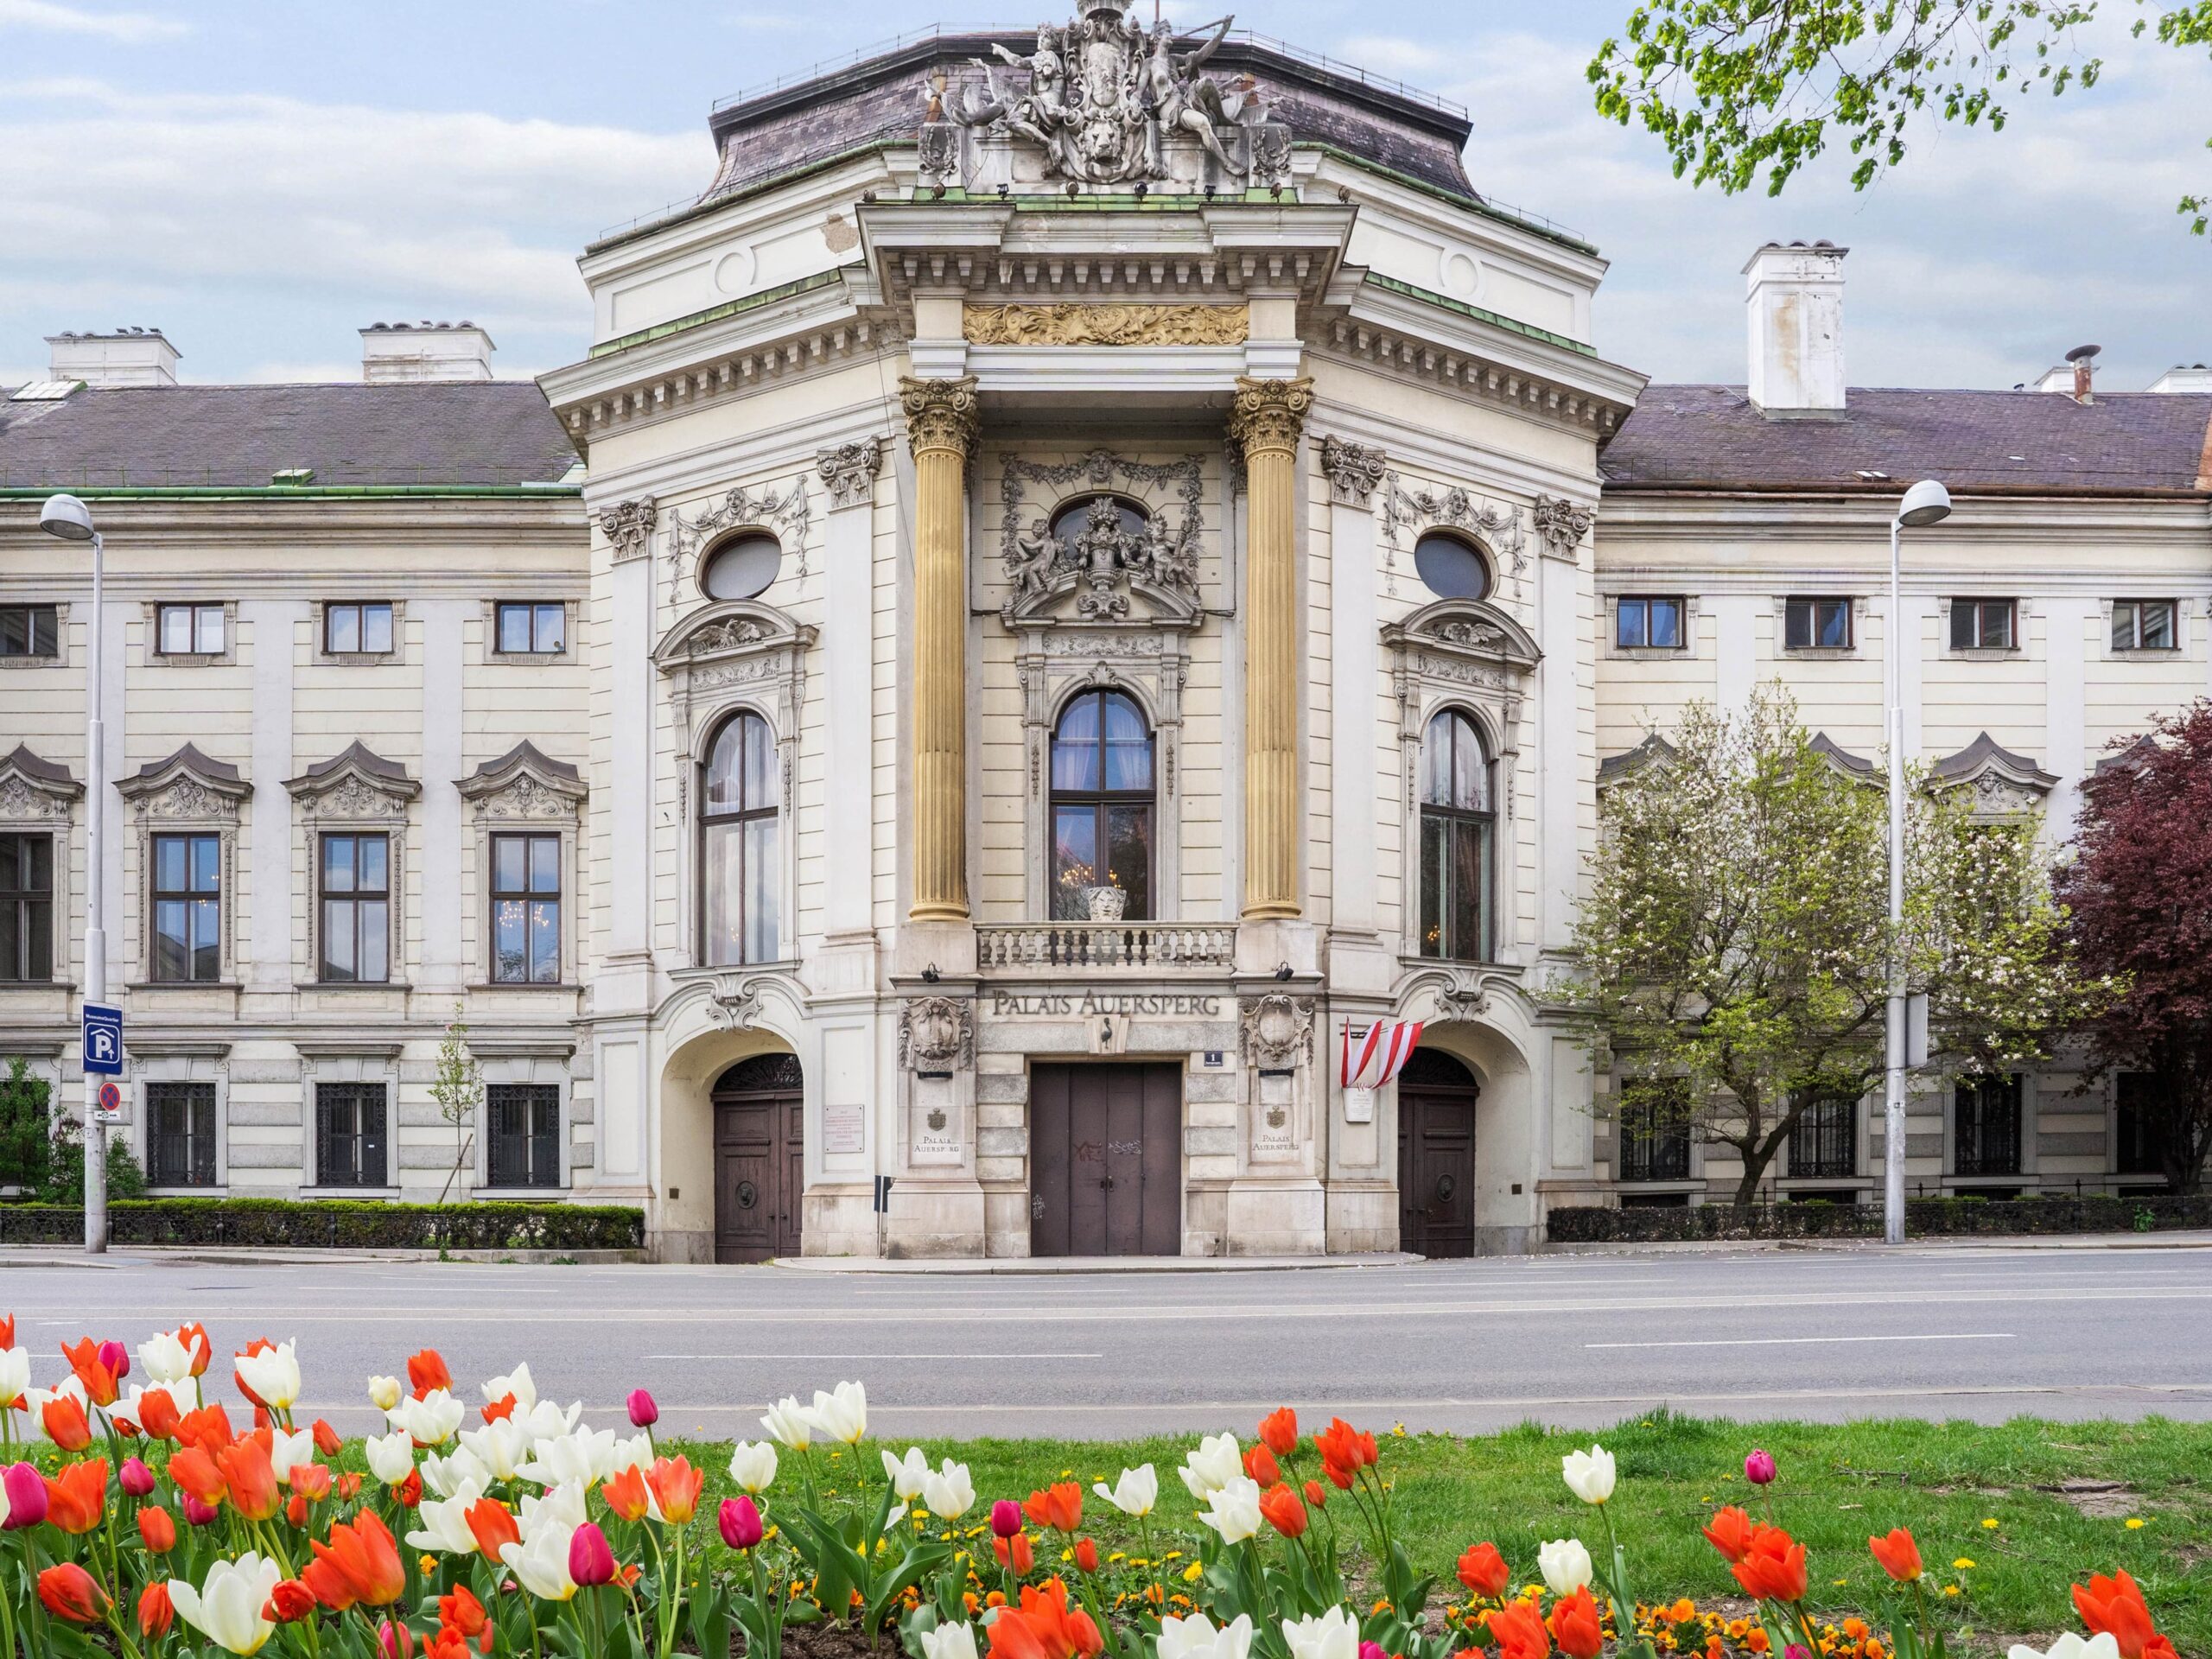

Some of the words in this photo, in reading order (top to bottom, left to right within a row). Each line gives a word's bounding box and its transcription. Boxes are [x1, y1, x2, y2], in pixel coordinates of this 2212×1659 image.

[993, 989, 1071, 1015] PALAIS
[1080, 988, 1220, 1016] AUERSPERG
[95, 1033, 112, 1058] P
[1211, 1053, 1216, 1062] 1
[923, 1135, 951, 1144] PALAIS
[1262, 1134, 1290, 1142] PALAIS
[914, 1144, 959, 1153] AUERSPRG
